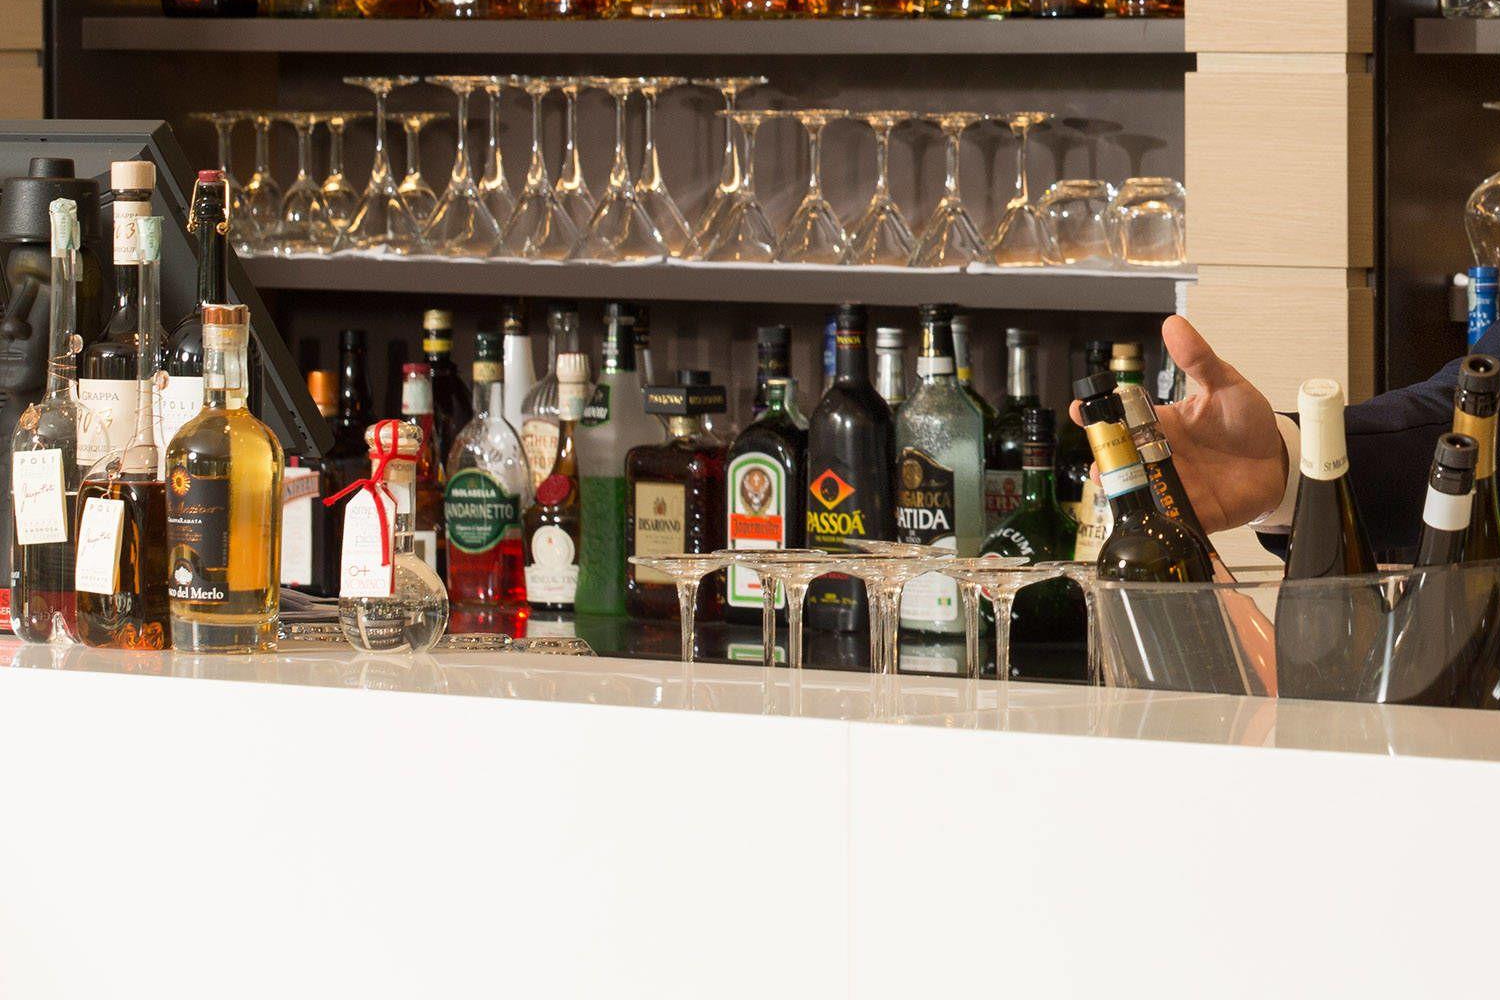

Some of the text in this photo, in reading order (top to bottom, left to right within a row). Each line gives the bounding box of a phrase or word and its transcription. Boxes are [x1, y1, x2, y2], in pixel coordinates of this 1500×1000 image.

[81, 390, 120, 401] GRAPPA
[20, 456, 56, 465] POLI
[638, 519, 681, 532] DISARONNO
[177, 585, 189, 598] del
[190, 586, 225, 601] Merlo
